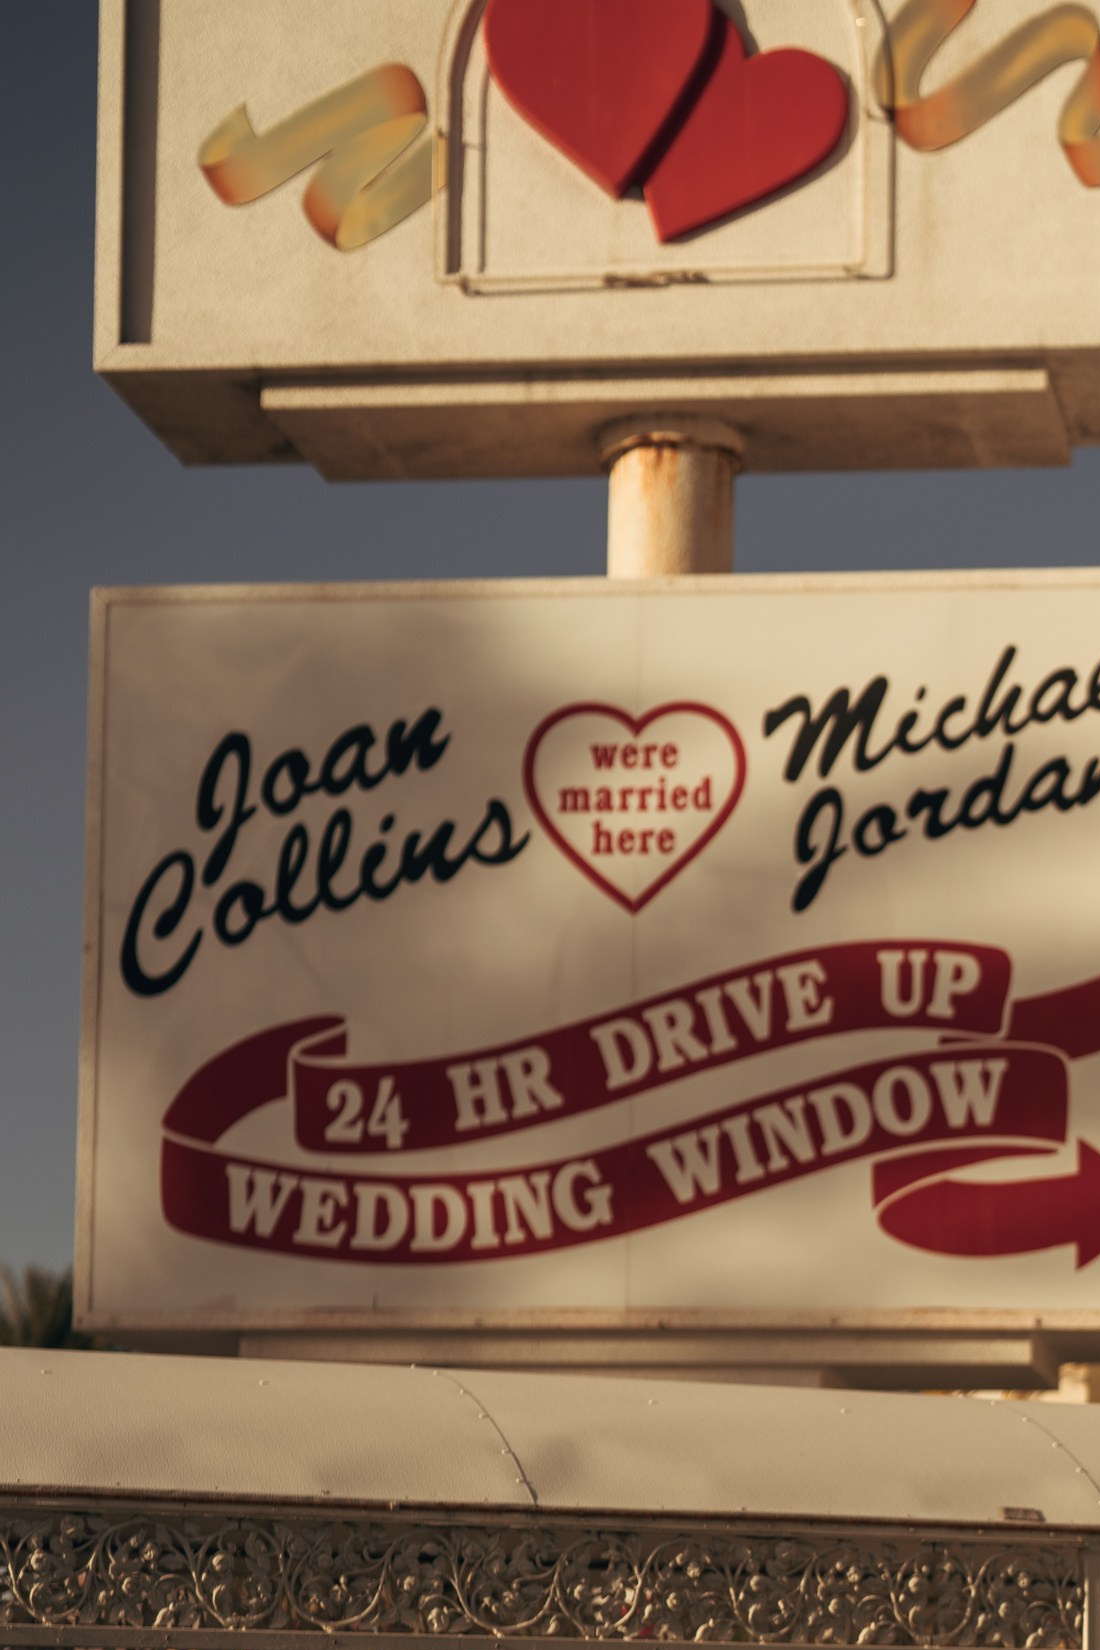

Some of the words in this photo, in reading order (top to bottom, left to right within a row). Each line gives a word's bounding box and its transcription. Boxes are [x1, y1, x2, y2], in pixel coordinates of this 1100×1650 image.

[196, 707, 450, 888] Joan
[557, 775, 714, 813] married
[589, 741, 679, 770] were
[591, 819, 676, 856] here
[119, 797, 531, 998] Collins
[324, 1076, 408, 1149] 24
[446, 1045, 564, 1131] HR
[590, 960, 834, 1091] DRIVE
[876, 949, 981, 1019] UP
[225, 1158, 613, 1252] WEDDING
[646, 1058, 1007, 1204] WINDOW
